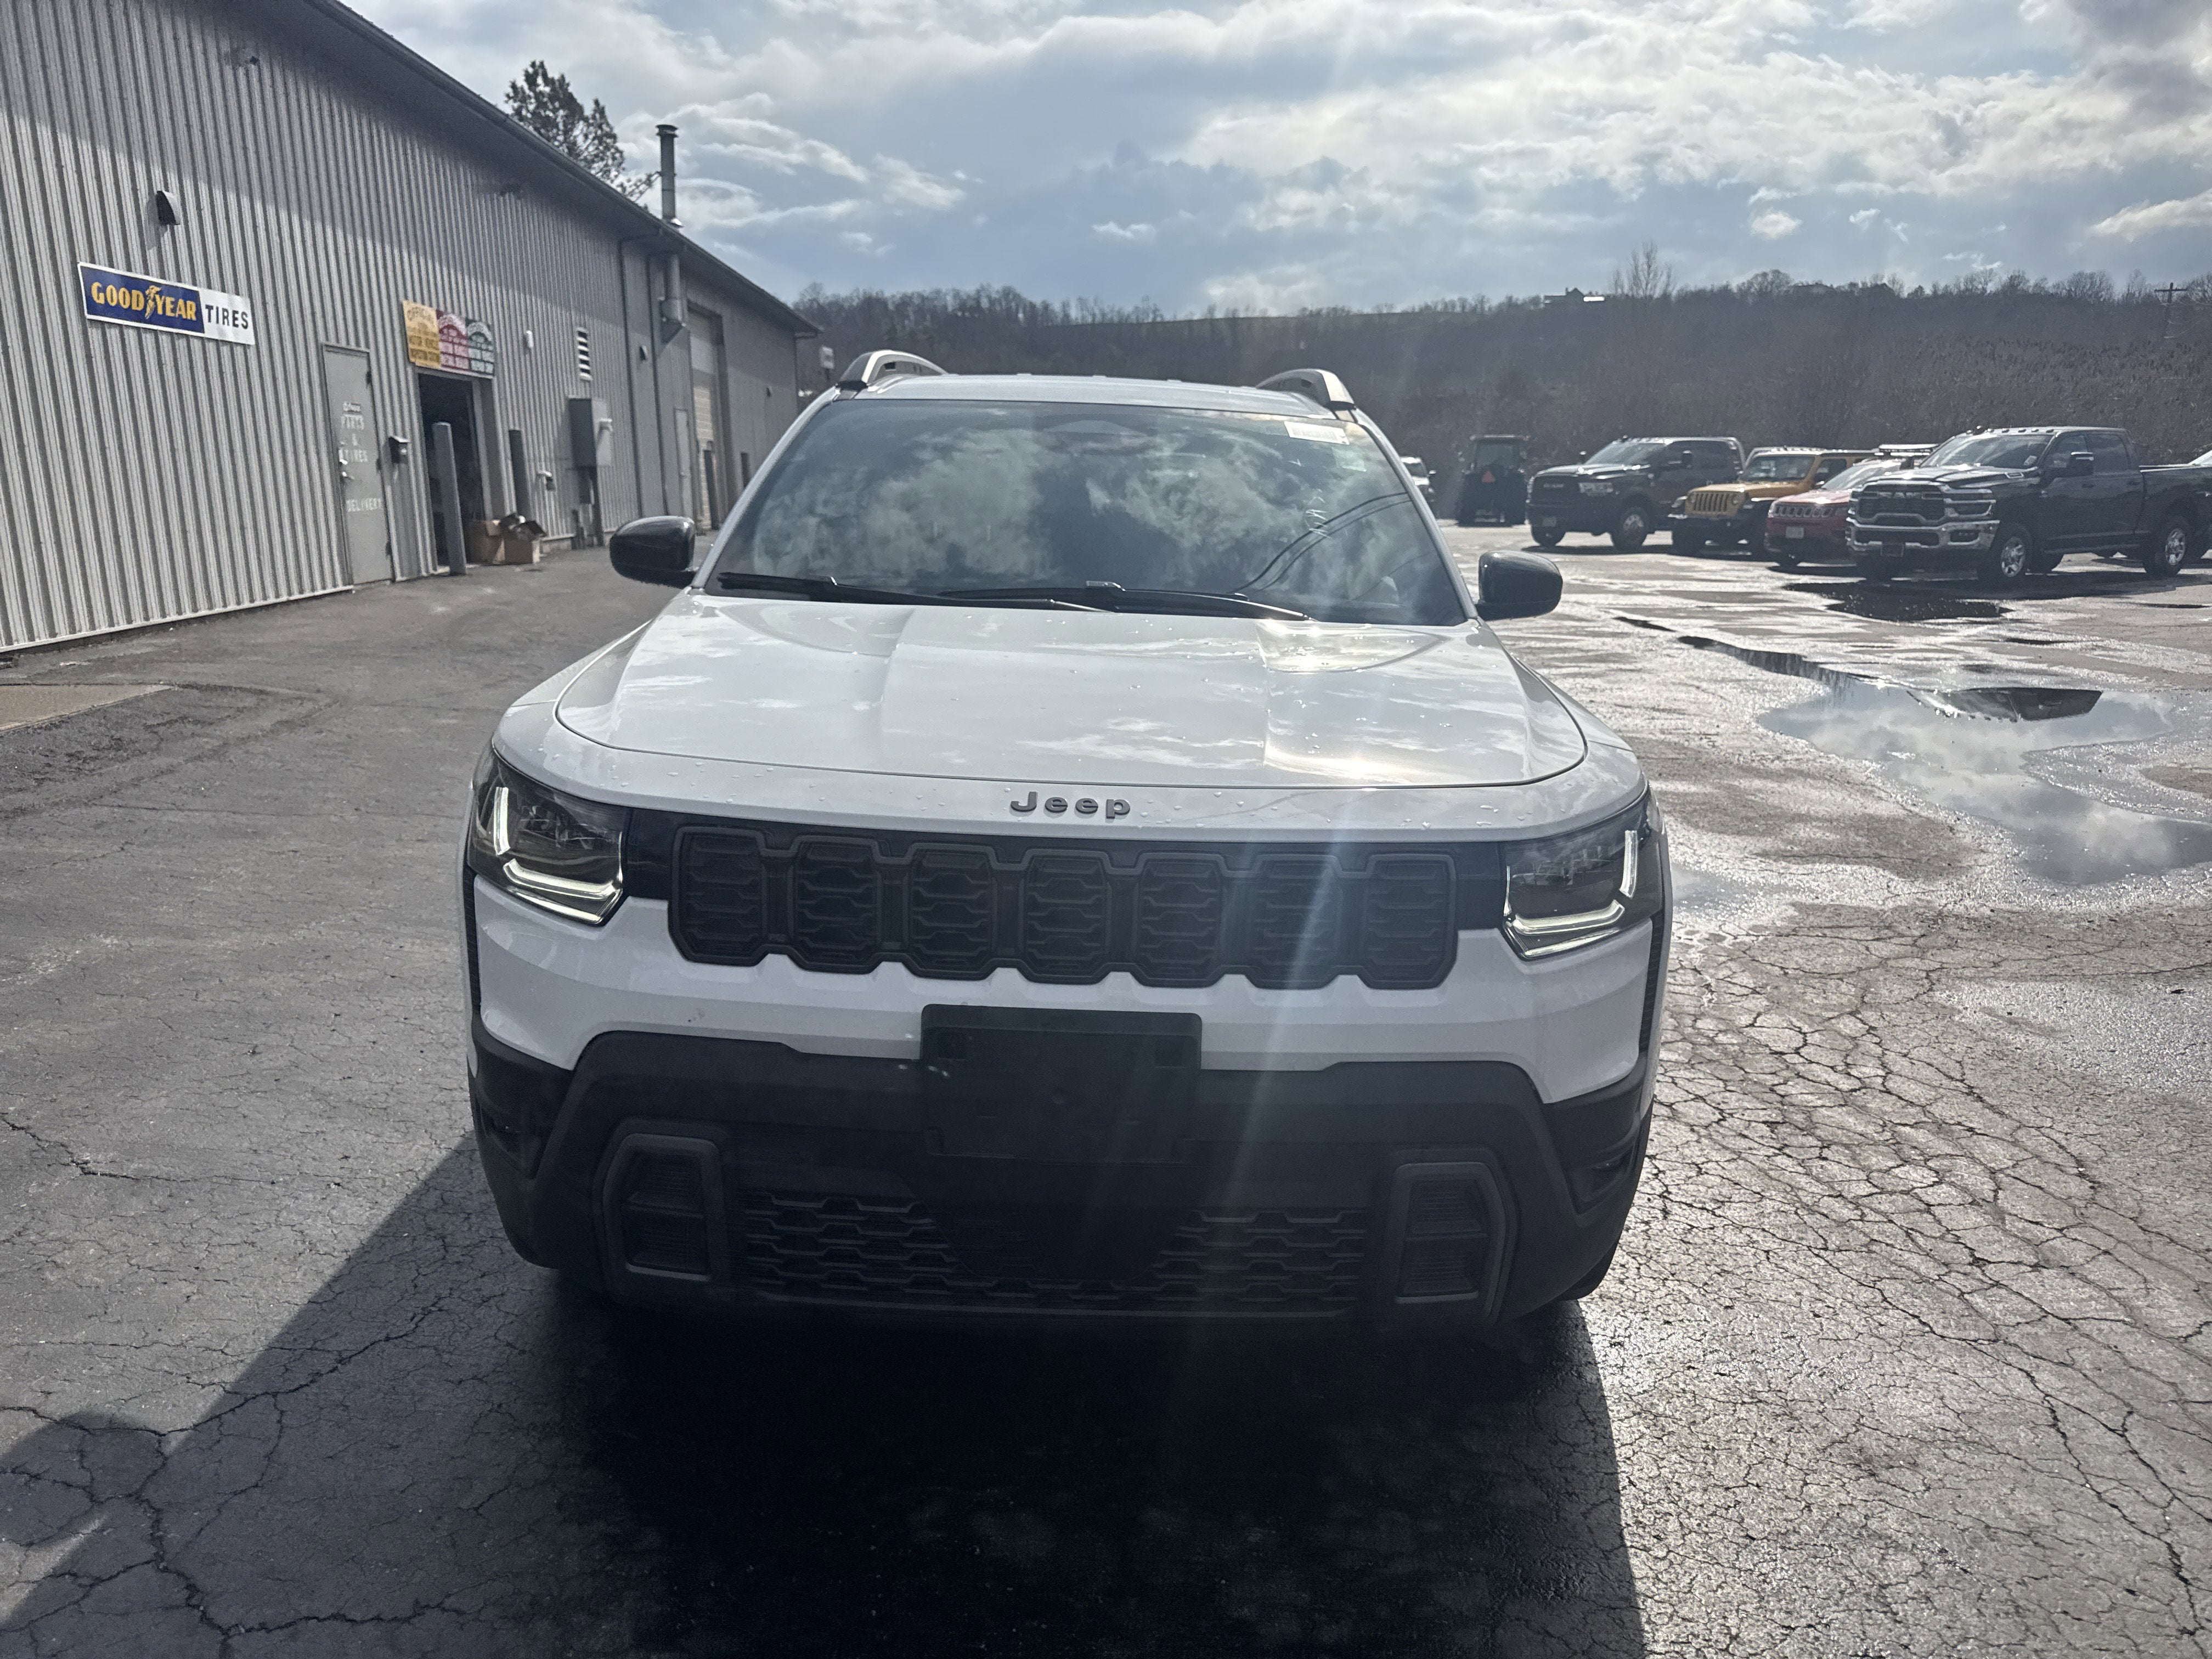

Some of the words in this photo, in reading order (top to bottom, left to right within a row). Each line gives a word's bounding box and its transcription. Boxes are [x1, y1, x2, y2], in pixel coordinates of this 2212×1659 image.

[91, 281, 197, 320] GOODYEAR
[205, 304, 249, 329] TIRES
[1011, 792, 1130, 819] Jeep
